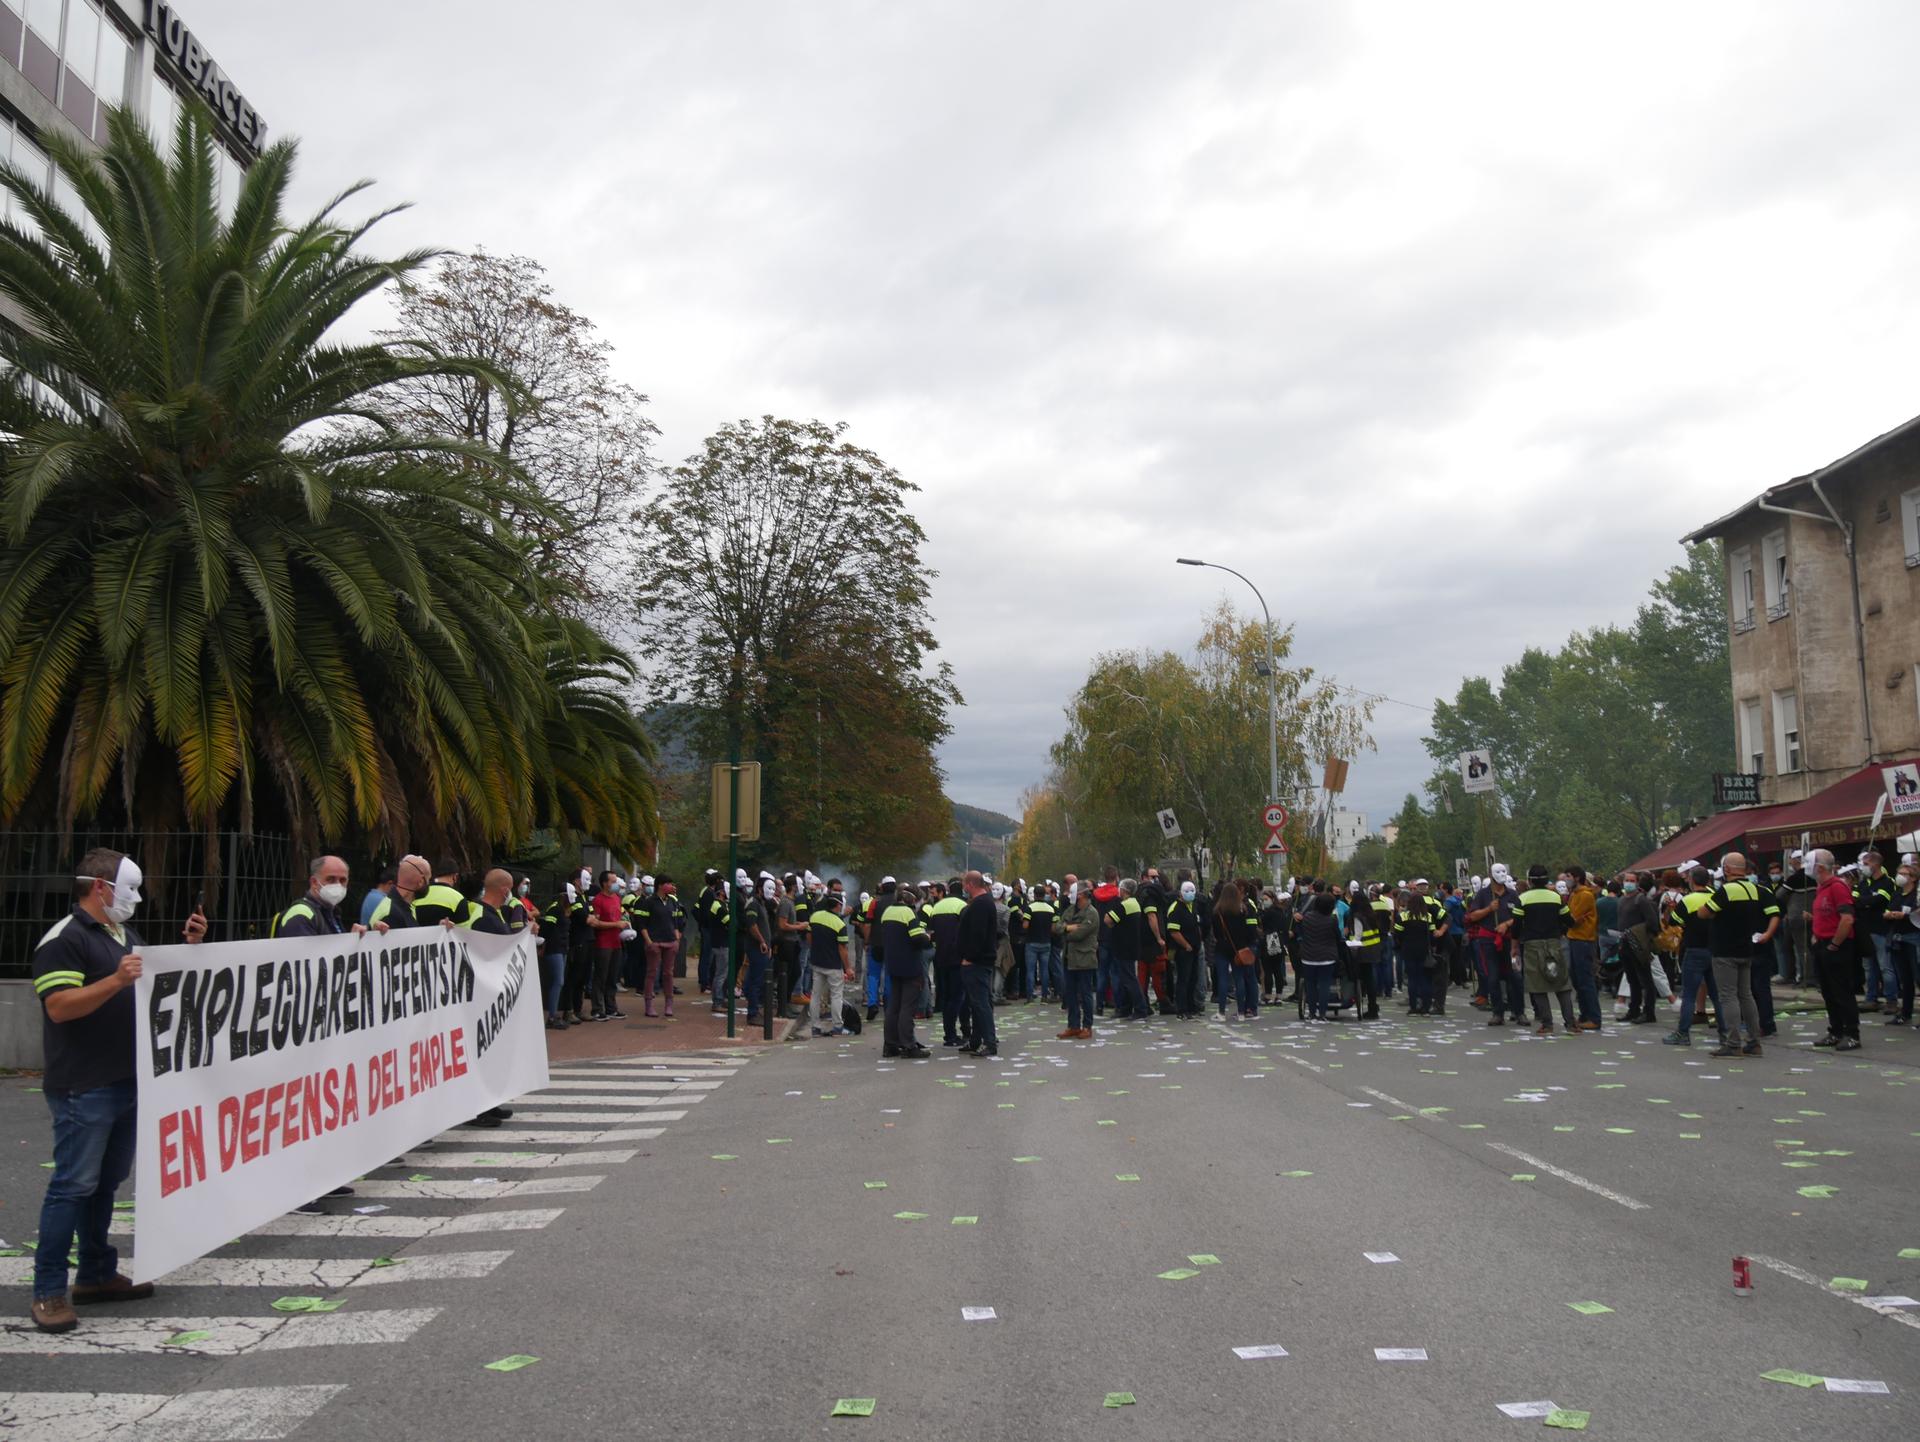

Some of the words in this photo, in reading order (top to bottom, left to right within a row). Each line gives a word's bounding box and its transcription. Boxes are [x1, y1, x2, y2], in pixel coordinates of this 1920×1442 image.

[1268, 813, 1281, 821] 40
[1723, 777, 1755, 788] BAR
[150, 951, 375, 1078] ENPLEGUAREN
[159, 1105, 206, 1199] EN
[218, 1062, 359, 1173] DEFENSA
[368, 1048, 404, 1116] DEL
[409, 1027, 468, 1097] EMPLE
